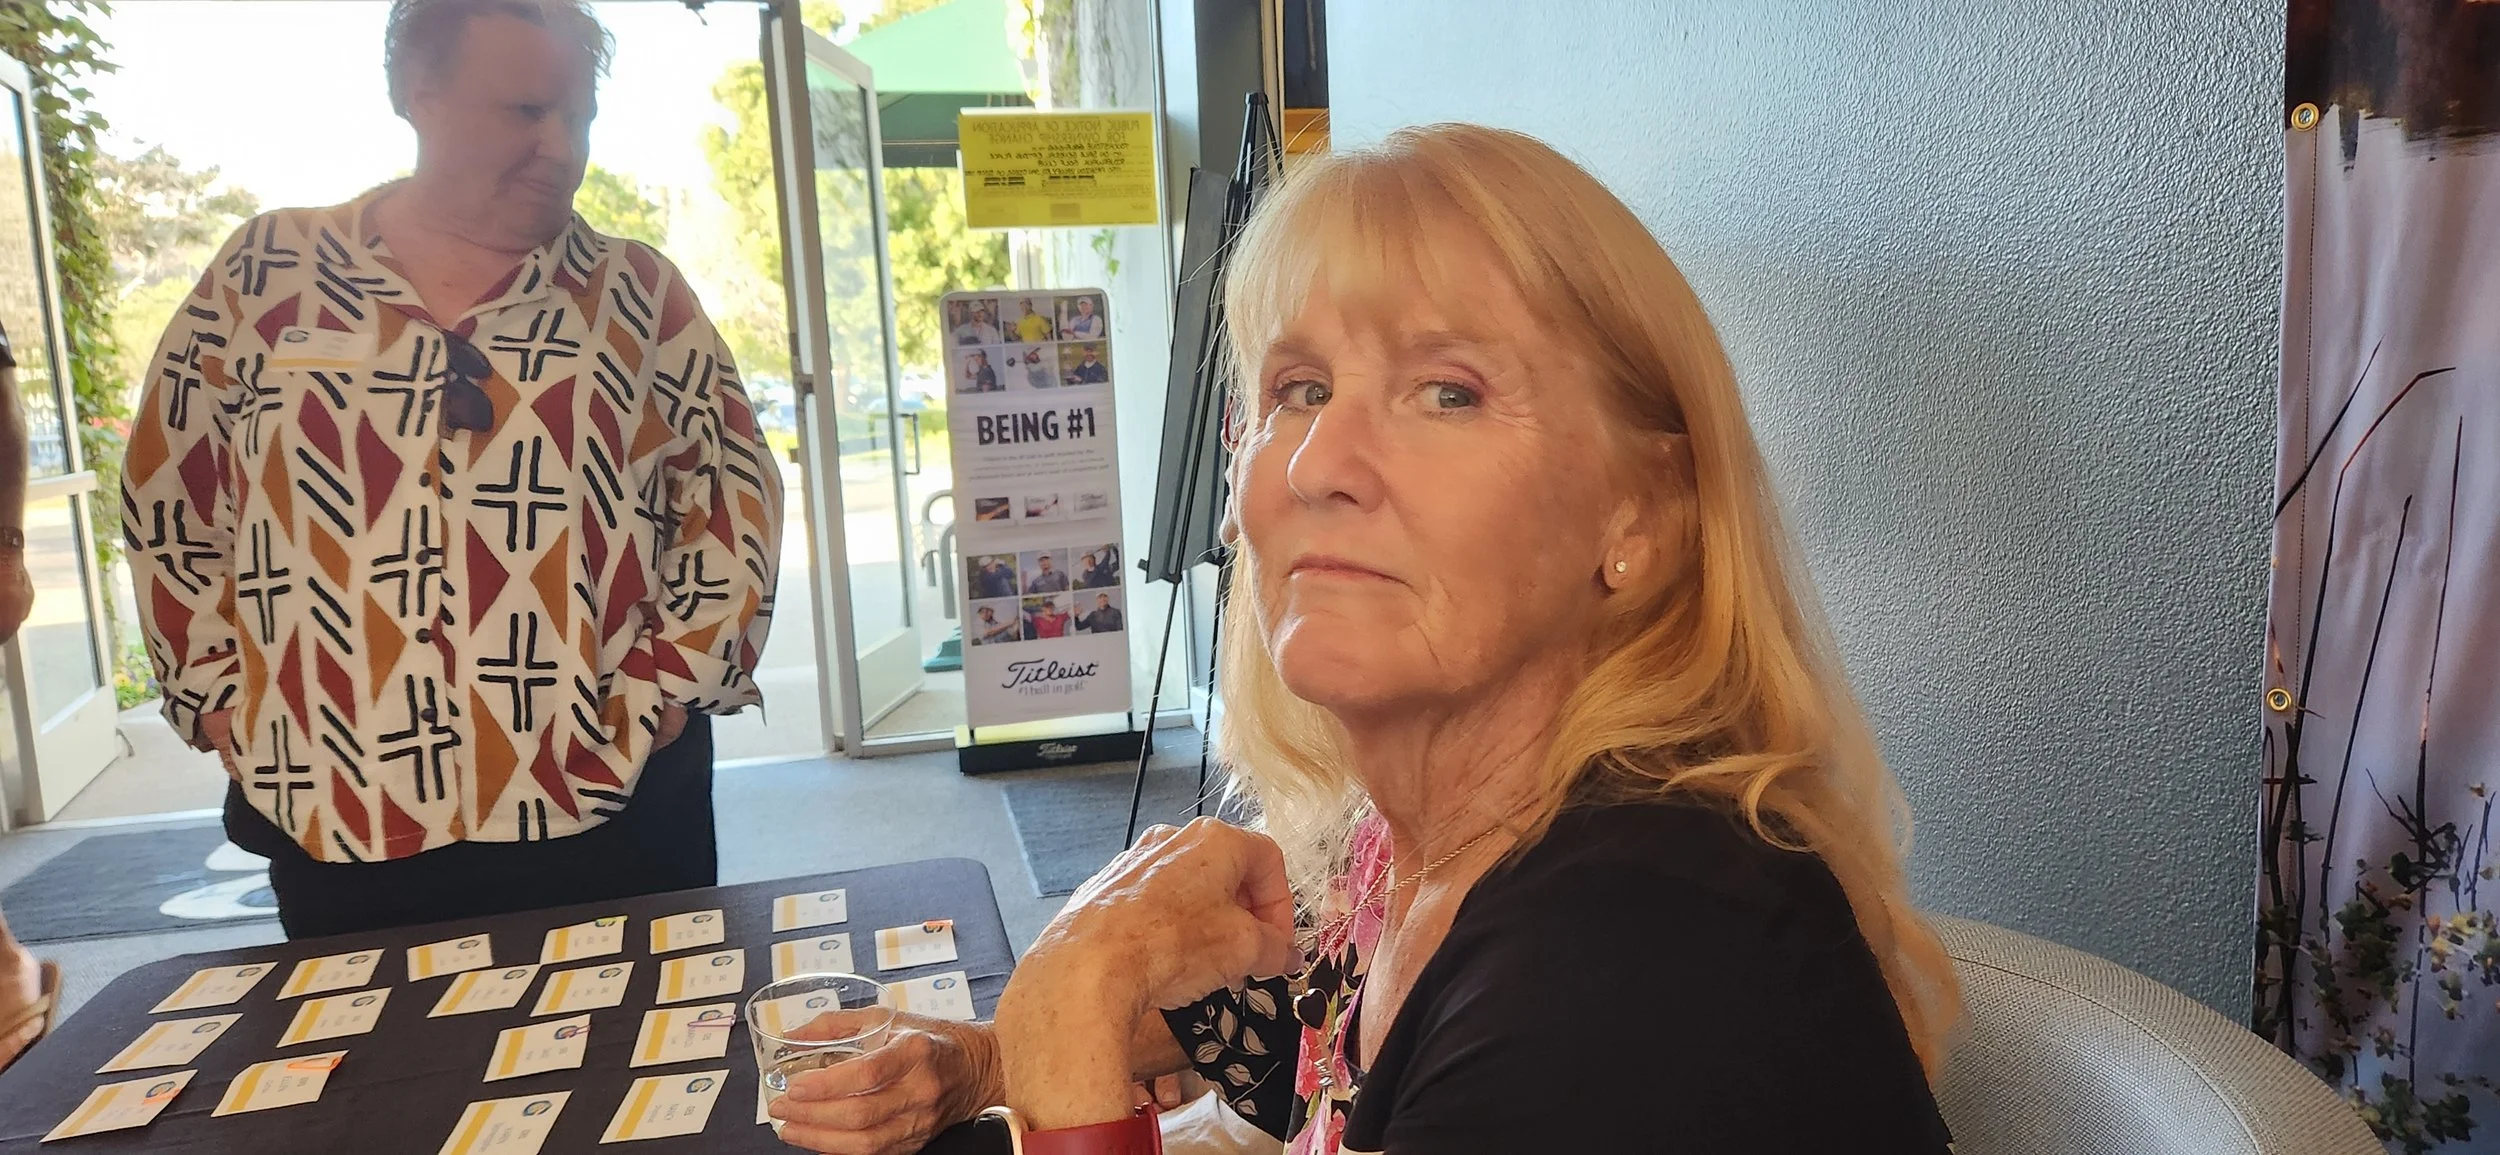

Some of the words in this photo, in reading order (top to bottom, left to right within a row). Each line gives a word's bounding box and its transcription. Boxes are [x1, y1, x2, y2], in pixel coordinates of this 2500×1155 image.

[976, 410, 1060, 446] BEING
[1067, 407, 1097, 440] #1
[1002, 658, 1099, 689] Titleist
